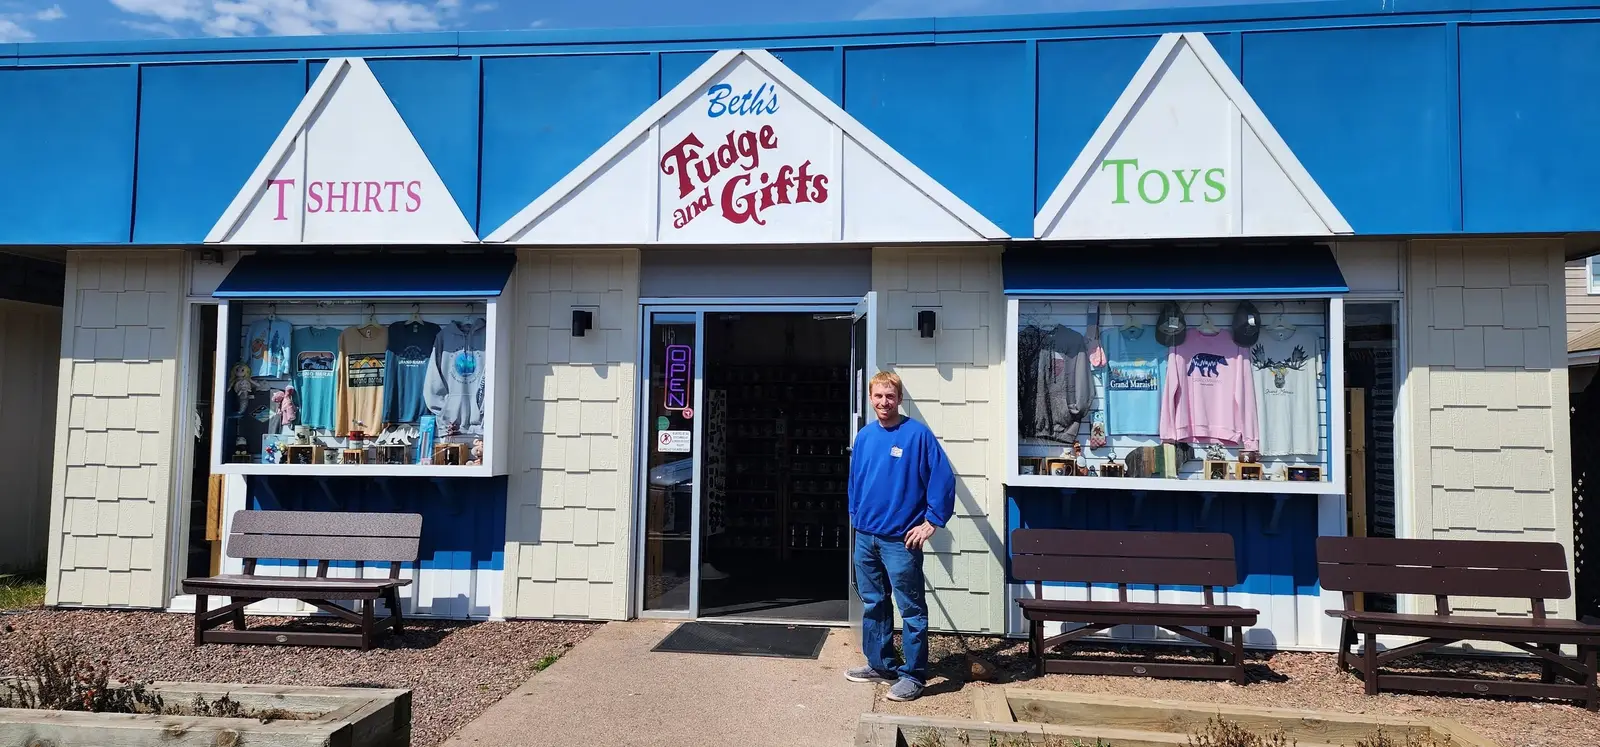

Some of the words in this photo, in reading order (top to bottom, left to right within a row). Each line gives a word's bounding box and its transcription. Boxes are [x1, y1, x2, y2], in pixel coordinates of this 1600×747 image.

[707, 82, 780, 118] Beth's
[660, 124, 778, 200] Fudge
[267, 178, 295, 221] T
[307, 180, 422, 213] SHIRTS
[673, 186, 715, 229] and
[720, 159, 829, 226] Gifts
[668, 349, 686, 407] OPEN
[1110, 380, 1129, 388] Grand
[1130, 380, 1150, 388] Marais
